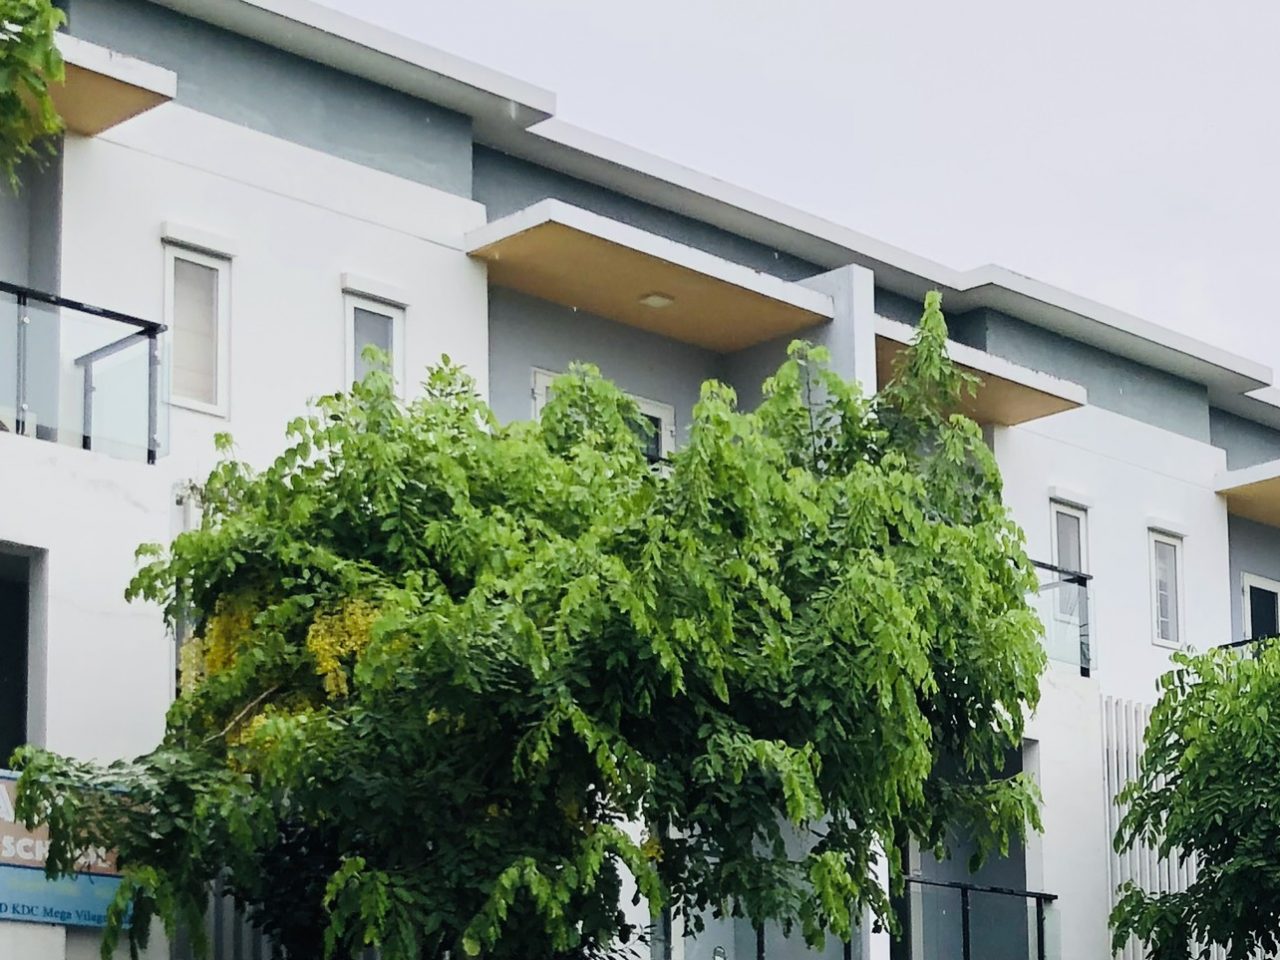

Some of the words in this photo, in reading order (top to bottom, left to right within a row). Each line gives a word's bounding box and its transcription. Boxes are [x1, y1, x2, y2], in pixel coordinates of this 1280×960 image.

[1, 835, 111, 868] SCHOL
[12, 903, 39, 916] KDC
[43, 906, 72, 921] Mega
